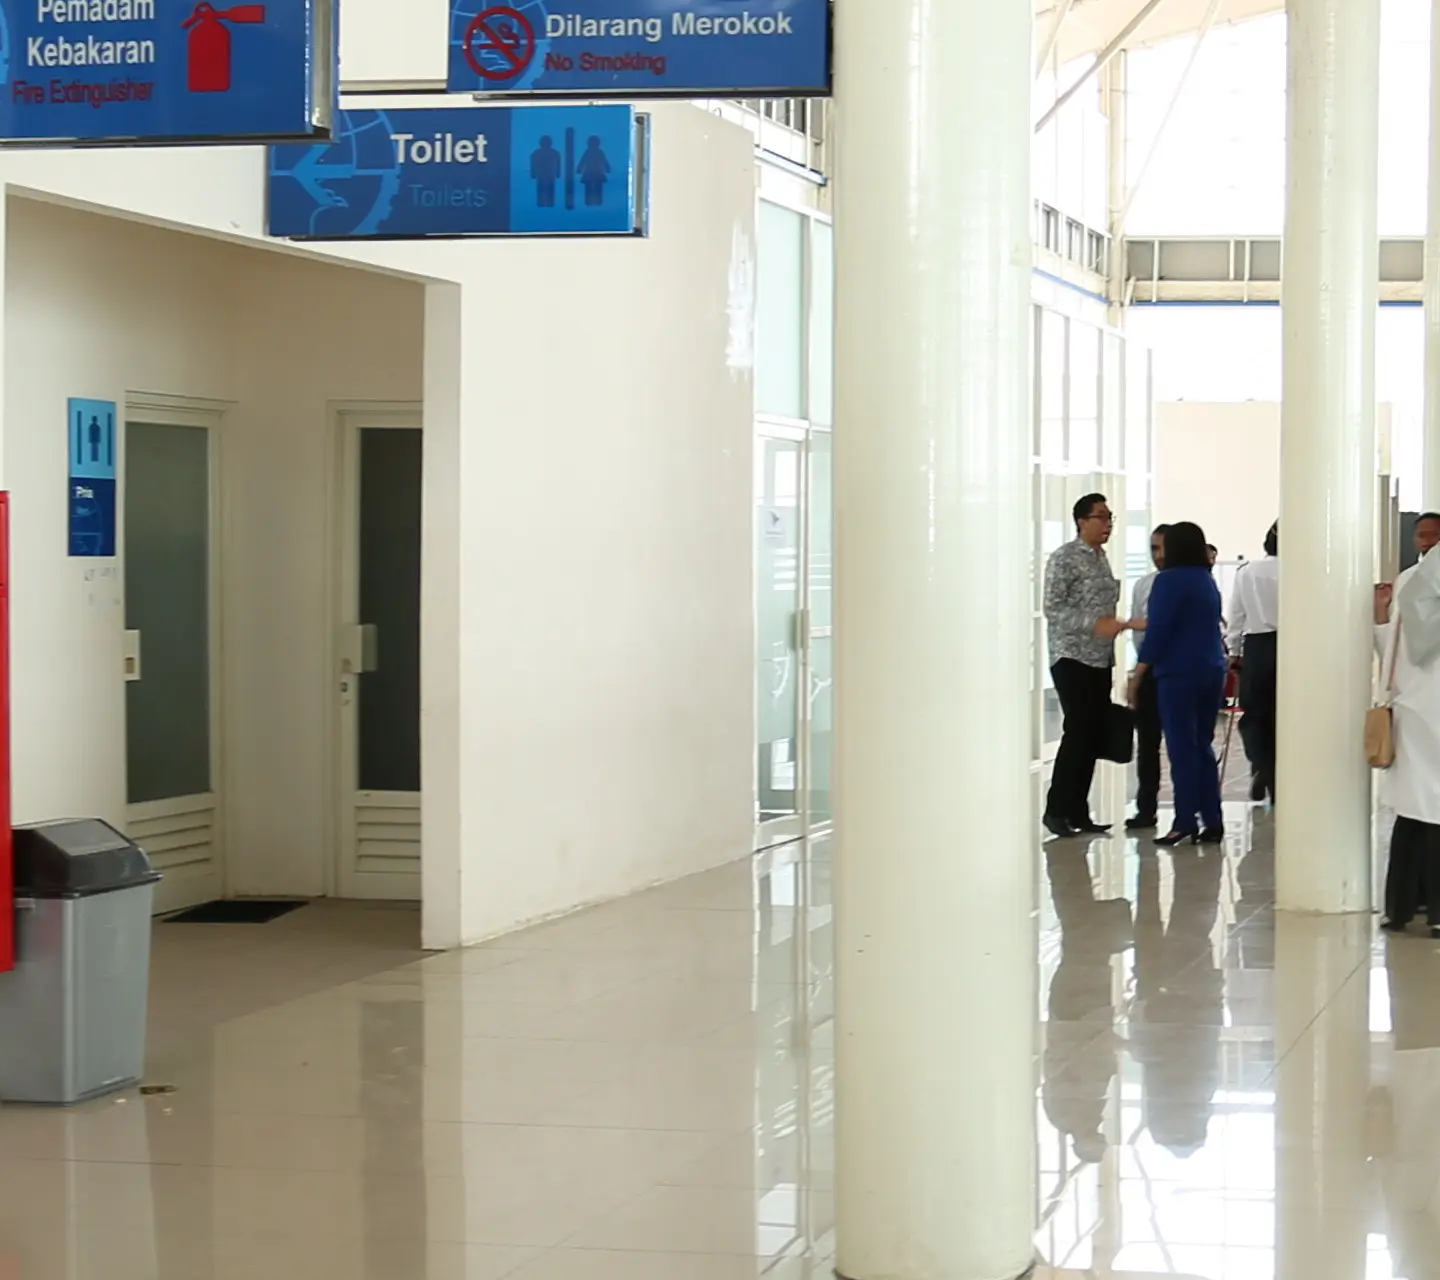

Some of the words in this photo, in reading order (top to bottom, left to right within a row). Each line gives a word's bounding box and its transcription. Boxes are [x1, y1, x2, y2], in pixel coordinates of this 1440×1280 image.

[546, 13, 662, 42] Dilarang
[672, 11, 793, 36] Merokok
[27, 34, 155, 67] Kebakaran
[546, 53, 573, 71] No
[579, 51, 666, 75] Smoking
[13, 79, 46, 105] Fire
[49, 77, 155, 109] Extinguisher
[389, 132, 488, 164] Toilet
[407, 183, 488, 207] Toilets
